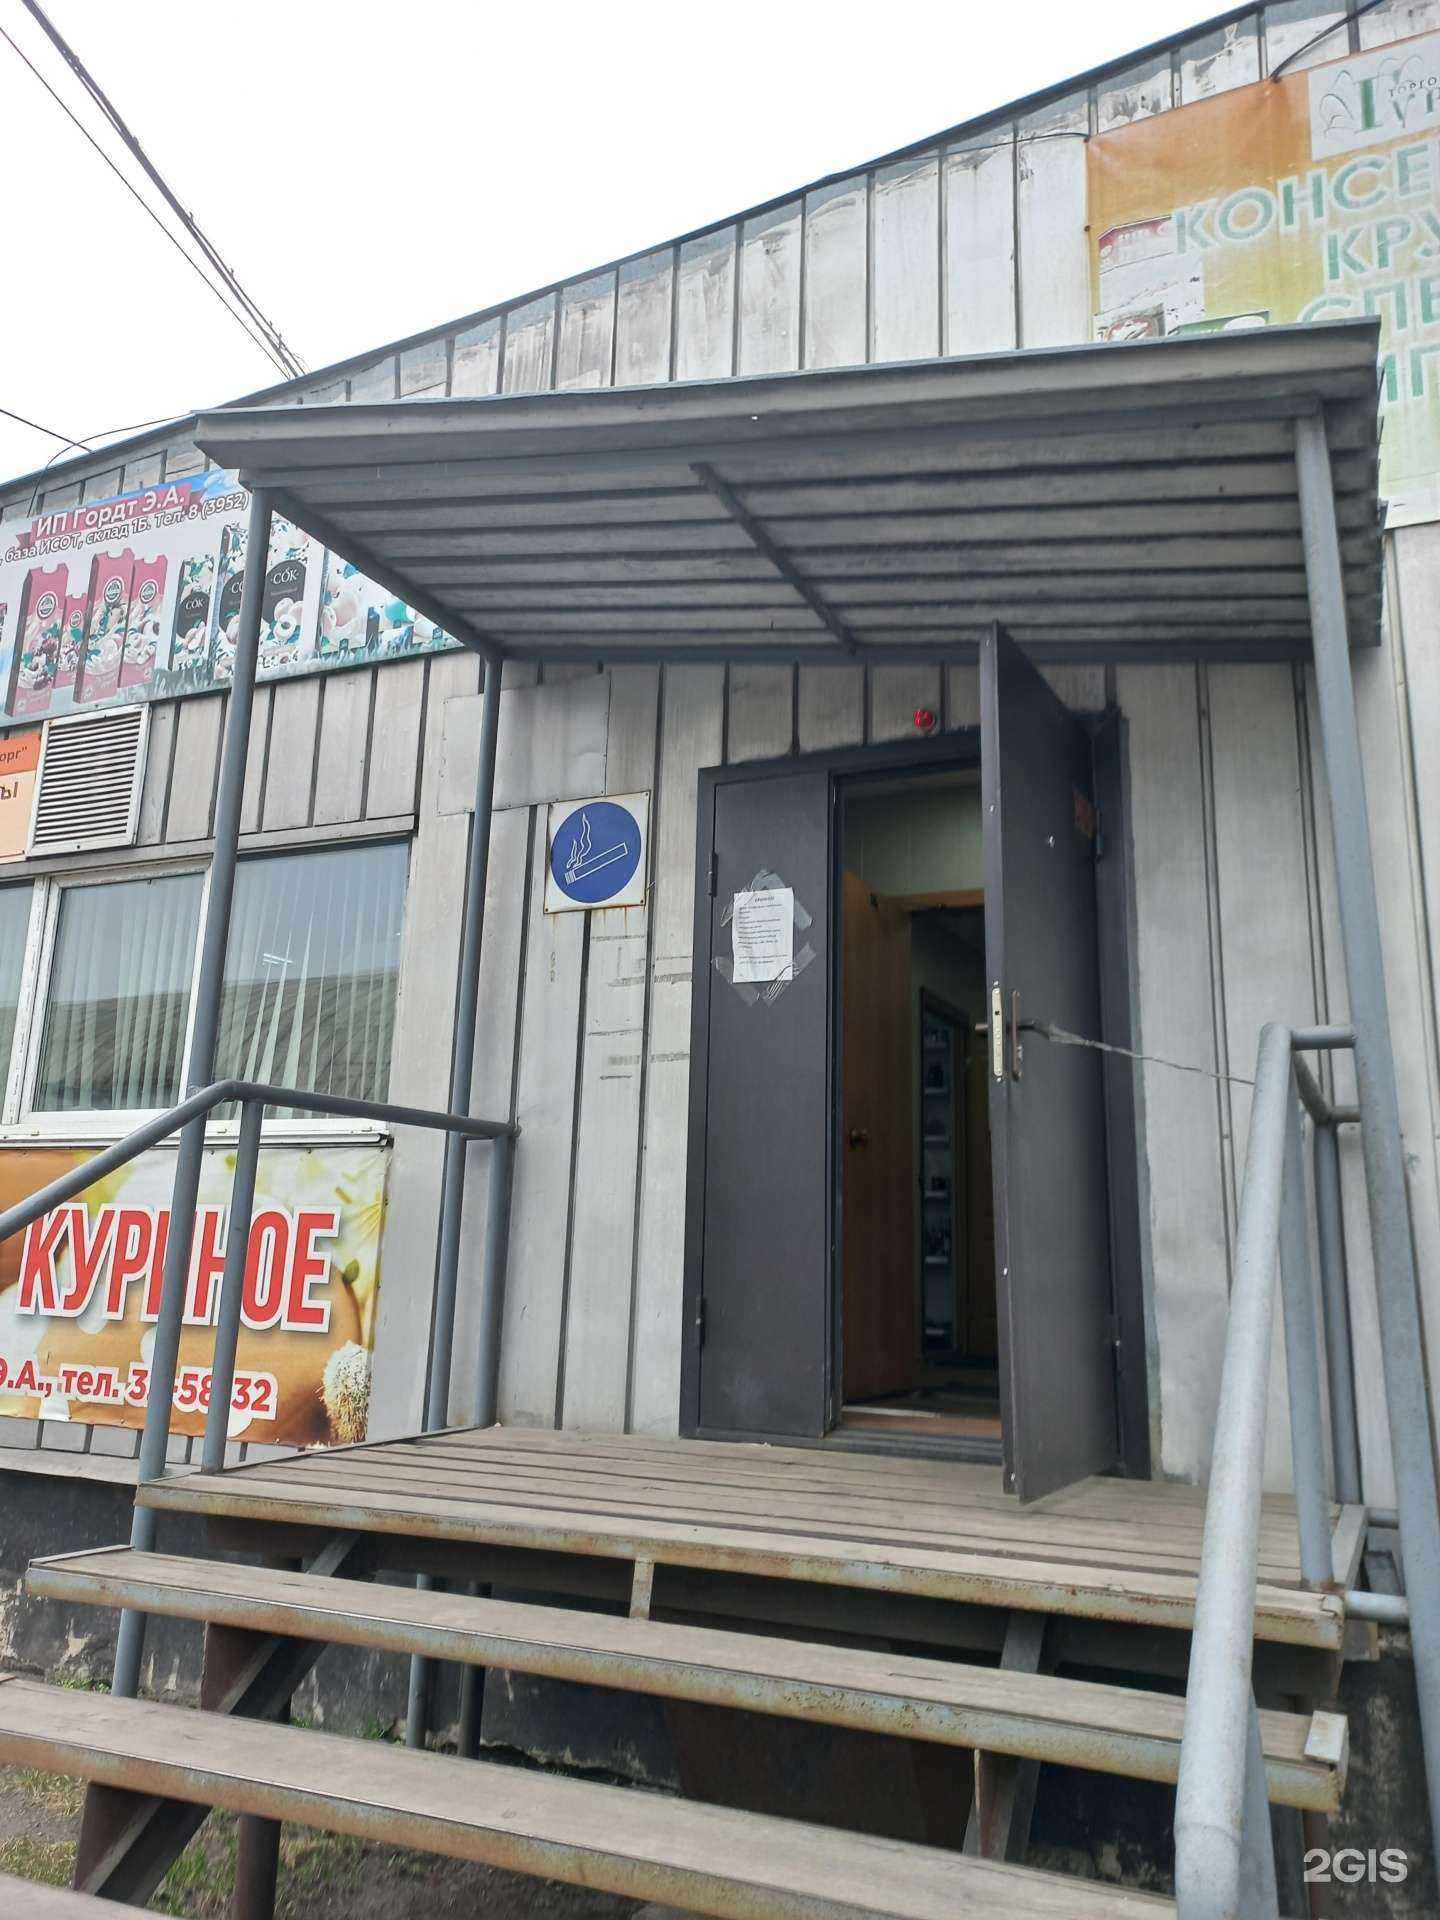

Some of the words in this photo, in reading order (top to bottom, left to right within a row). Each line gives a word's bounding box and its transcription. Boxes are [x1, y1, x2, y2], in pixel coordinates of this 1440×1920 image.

[4, 545, 38, 563] база
[85, 523, 130, 546] склад
[188, 503, 200, 521] 8
[201, 489, 250, 520] (3952)
[35, 513, 68, 538] ИП
[71, 500, 139, 530] Гордт
[141, 485, 185, 513] Э.А.
[62, 1369, 119, 1398] тел.
